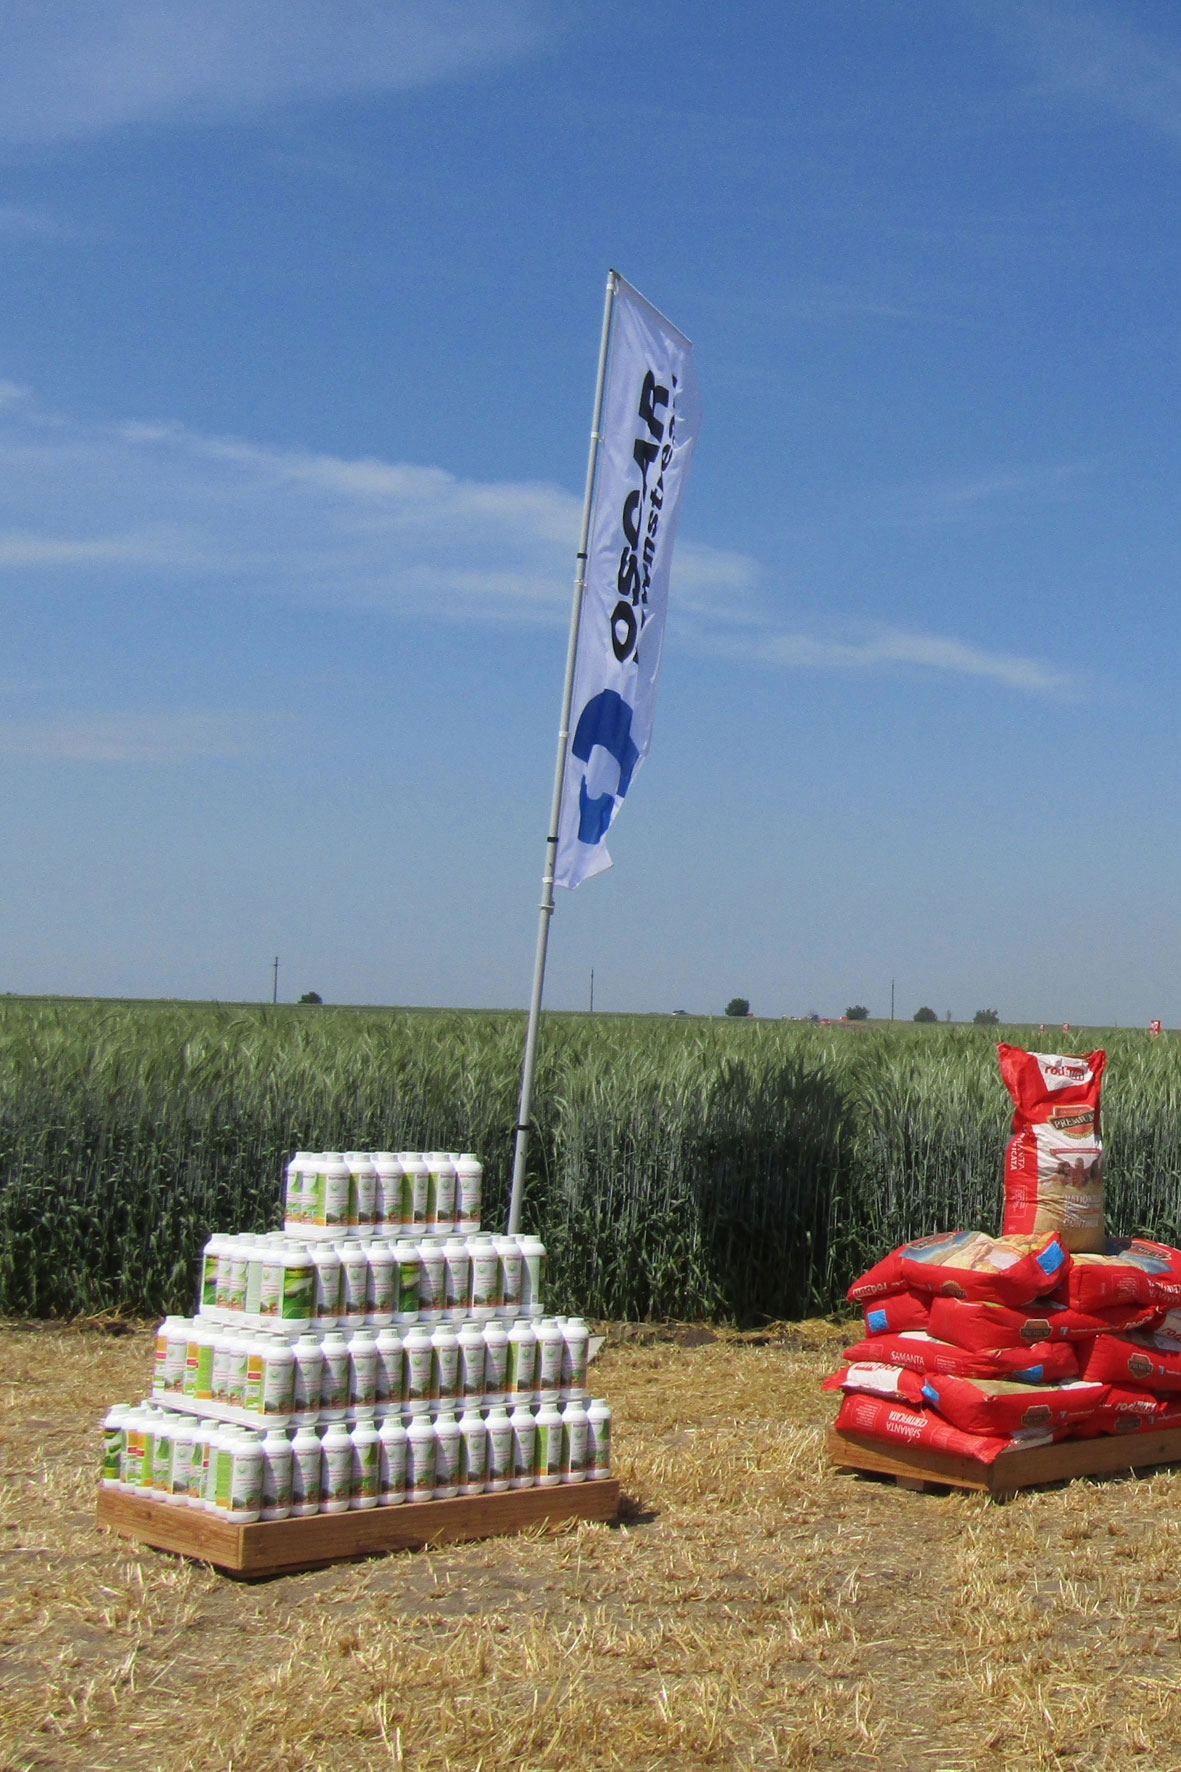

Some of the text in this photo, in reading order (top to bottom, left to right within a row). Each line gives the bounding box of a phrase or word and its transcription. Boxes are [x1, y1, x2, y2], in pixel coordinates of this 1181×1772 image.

[611, 370, 669, 662] OSCAR
[891, 1350, 925, 1366] SAMANTA
[889, 1410, 928, 1427] CERTIFICATA
[886, 1421, 922, 1438] SAMANTA
